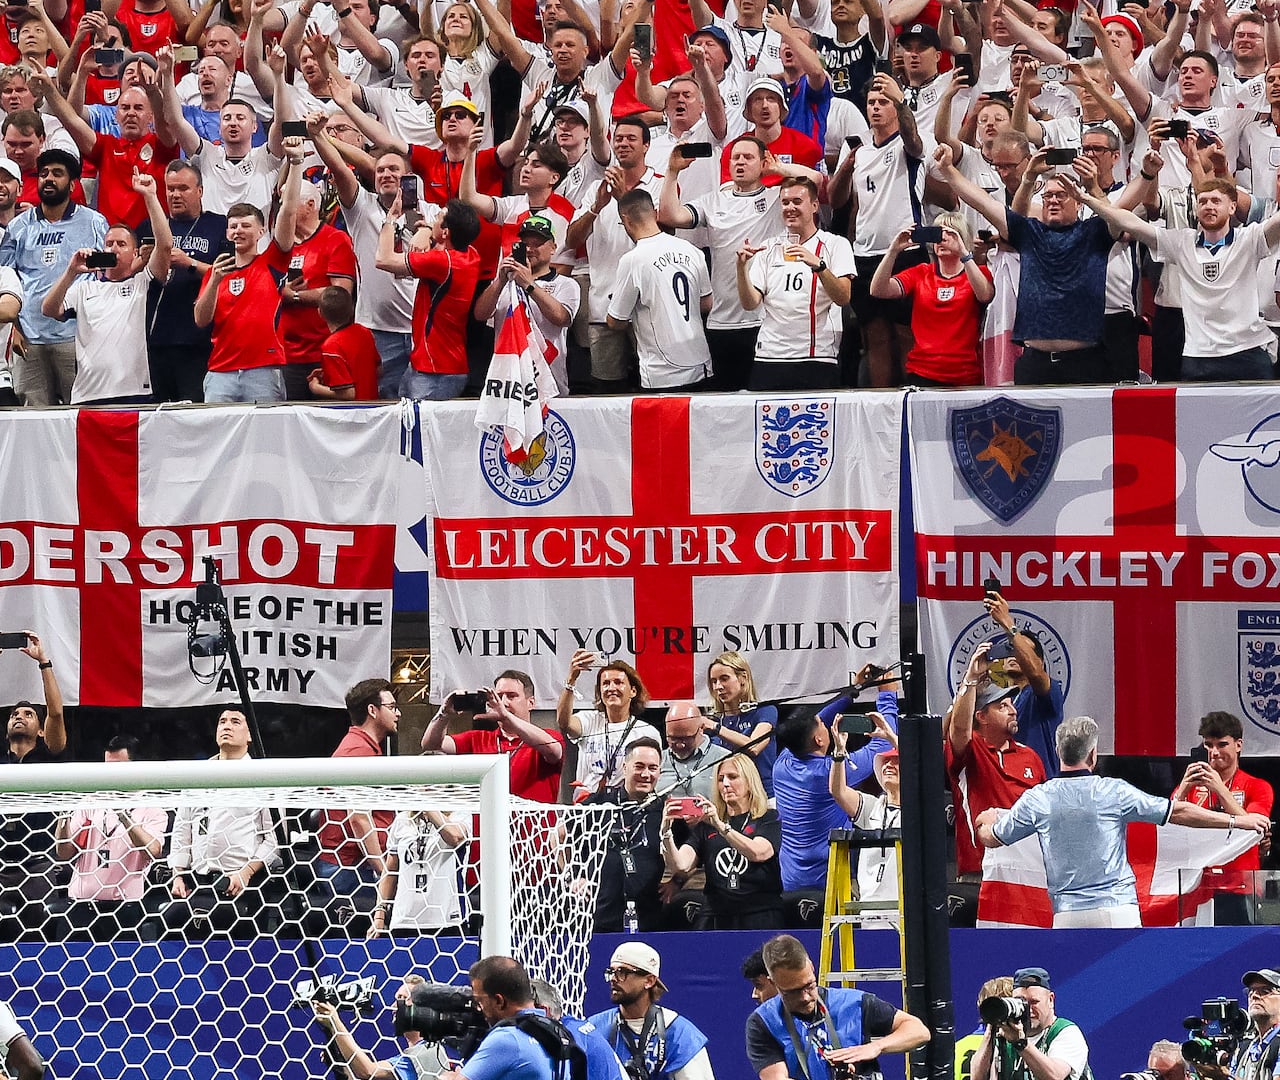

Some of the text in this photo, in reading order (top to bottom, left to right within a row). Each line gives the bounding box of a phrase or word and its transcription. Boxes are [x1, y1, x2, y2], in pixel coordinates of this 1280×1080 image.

[866, 175, 877, 193] 4
[36, 231, 66, 246] NIKE
[653, 251, 691, 273] FOWLER
[672, 271, 690, 323] 9
[783, 272, 804, 292] 16
[550, 420, 572, 454] CITY
[485, 455, 572, 503] FOOTBALL CLUB
[442, 520, 878, 568] LEICESTER CITY
[927, 550, 1185, 589] HINCKLEY
[257, 595, 305, 621] OF
[312, 598, 384, 626] THE
[448, 619, 879, 656] WHEN YOU'RE SMILING
[956, 617, 1034, 667] LEICESER
[215, 666, 317, 694] ARMY
